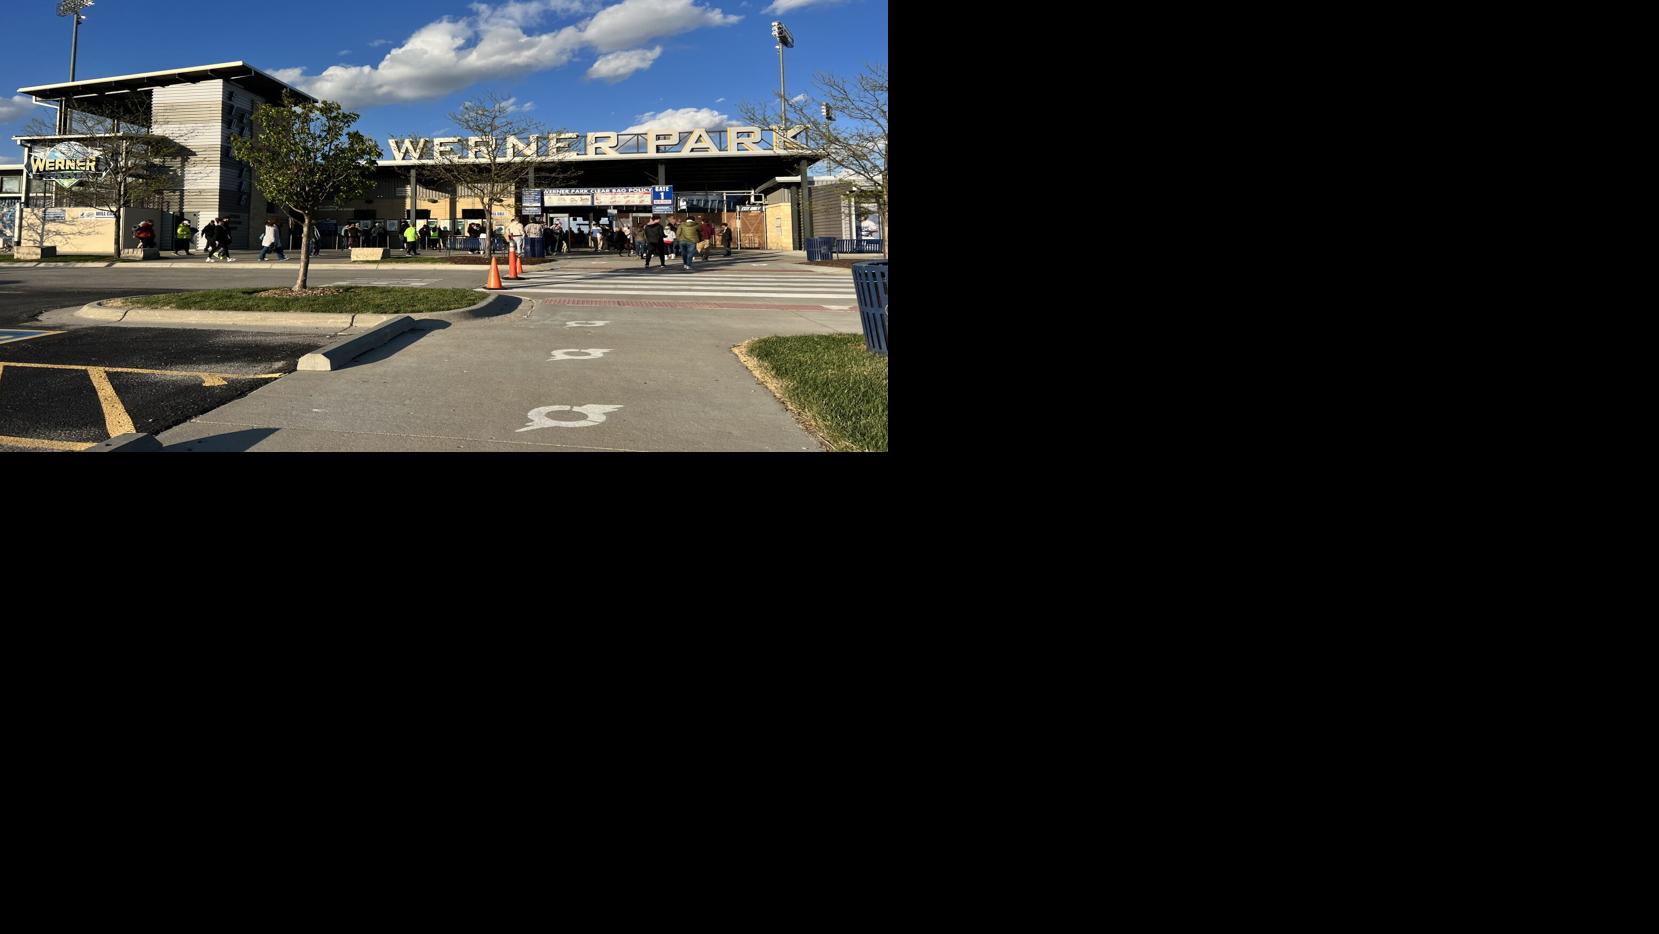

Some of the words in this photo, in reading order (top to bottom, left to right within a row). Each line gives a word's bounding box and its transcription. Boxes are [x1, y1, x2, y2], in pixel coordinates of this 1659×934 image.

[387, 131, 620, 161] WERNER
[646, 125, 811, 154] PARK
[31, 156, 96, 174] WERNER
[660, 192, 665, 200] 1
